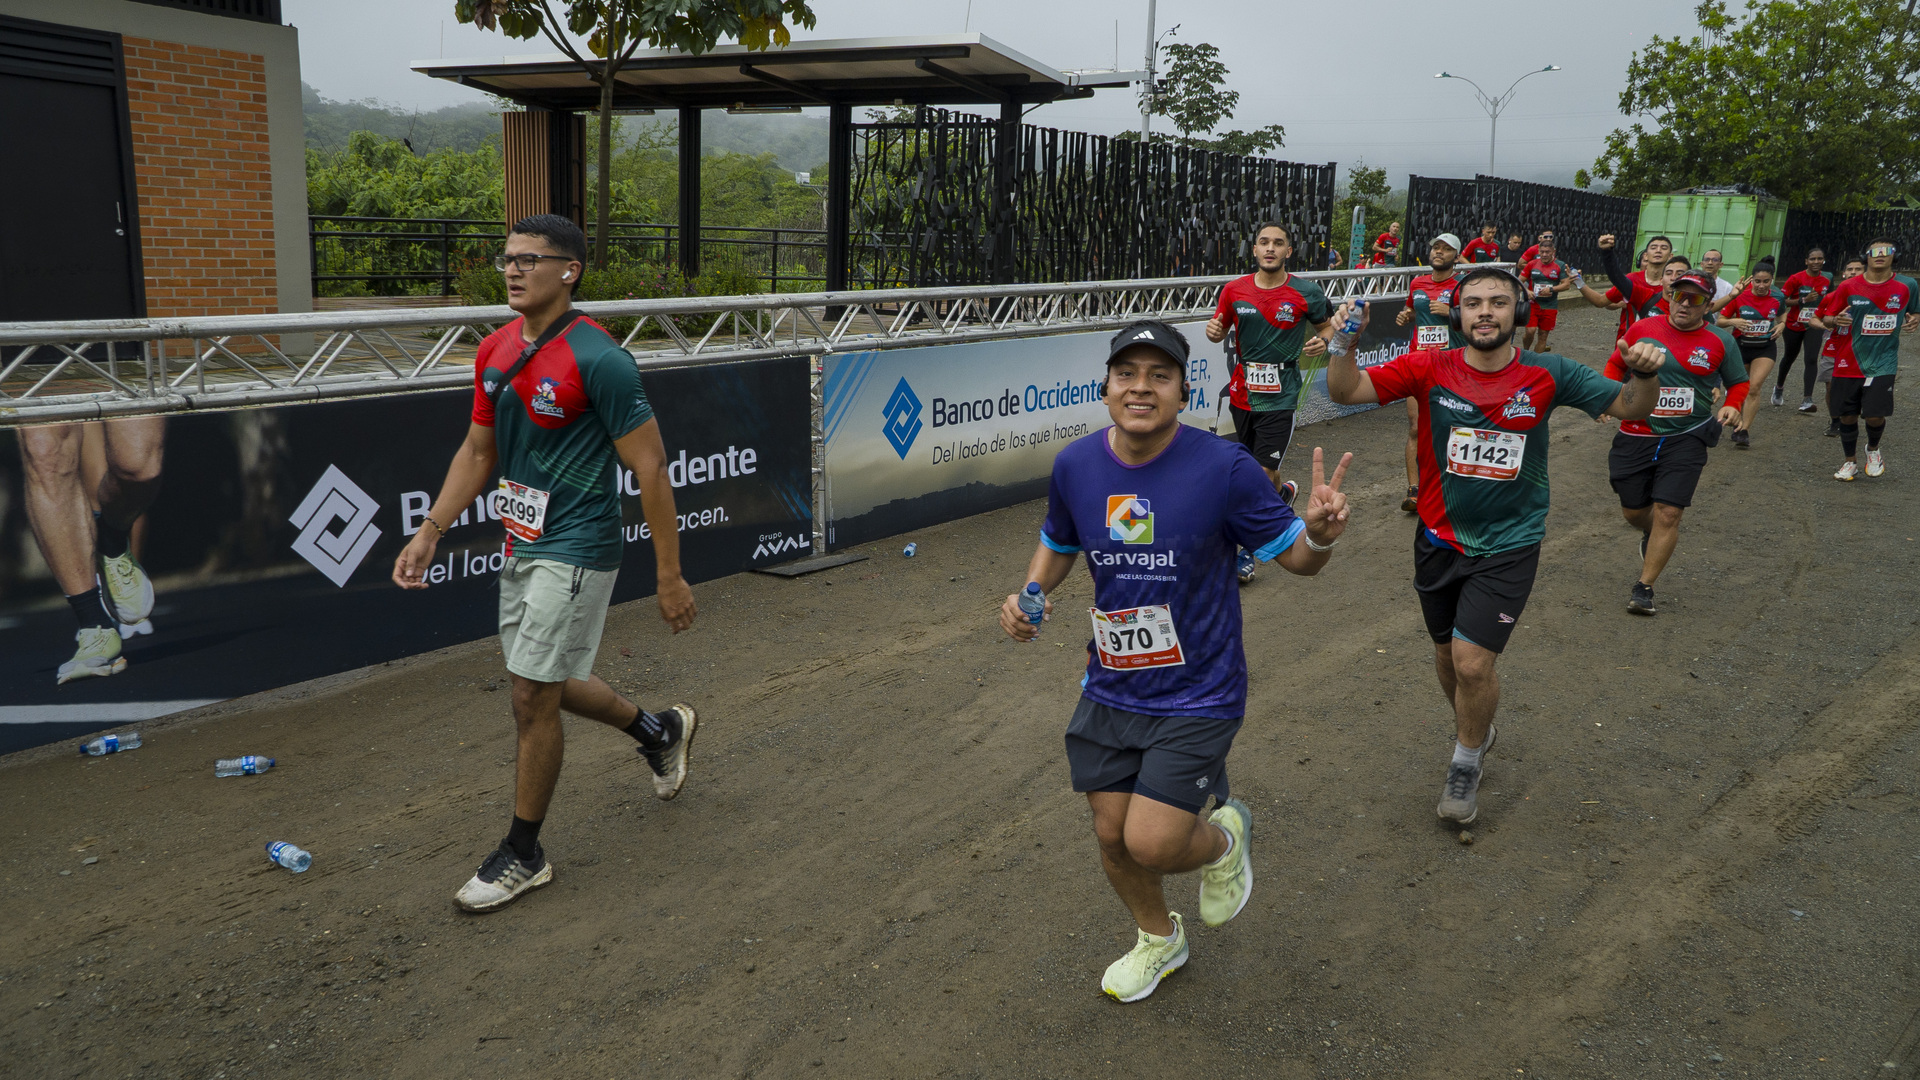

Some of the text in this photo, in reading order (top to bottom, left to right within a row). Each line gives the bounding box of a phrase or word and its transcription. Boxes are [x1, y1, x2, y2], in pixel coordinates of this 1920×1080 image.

[1867, 321, 1891, 329] 1665
[1420, 333, 1442, 342] 1021
[1378, 344, 1389, 362] de
[1249, 372, 1275, 383] 1113
[932, 397, 993, 428] Banco
[998, 388, 1020, 417] de
[1655, 396, 1685, 408] 069
[932, 422, 1089, 465] Del lado de los que hacen.
[1459, 443, 1509, 466] 1142
[499, 495, 536, 524] 2099
[420, 552, 453, 584] el
[463, 542, 506, 578] lad
[676, 506, 729, 532] acen.
[752, 533, 810, 560] AVAL
[758, 531, 783, 542] Grupo
[1090, 549, 1177, 571] Carvajal
[1108, 627, 1153, 652] 970
